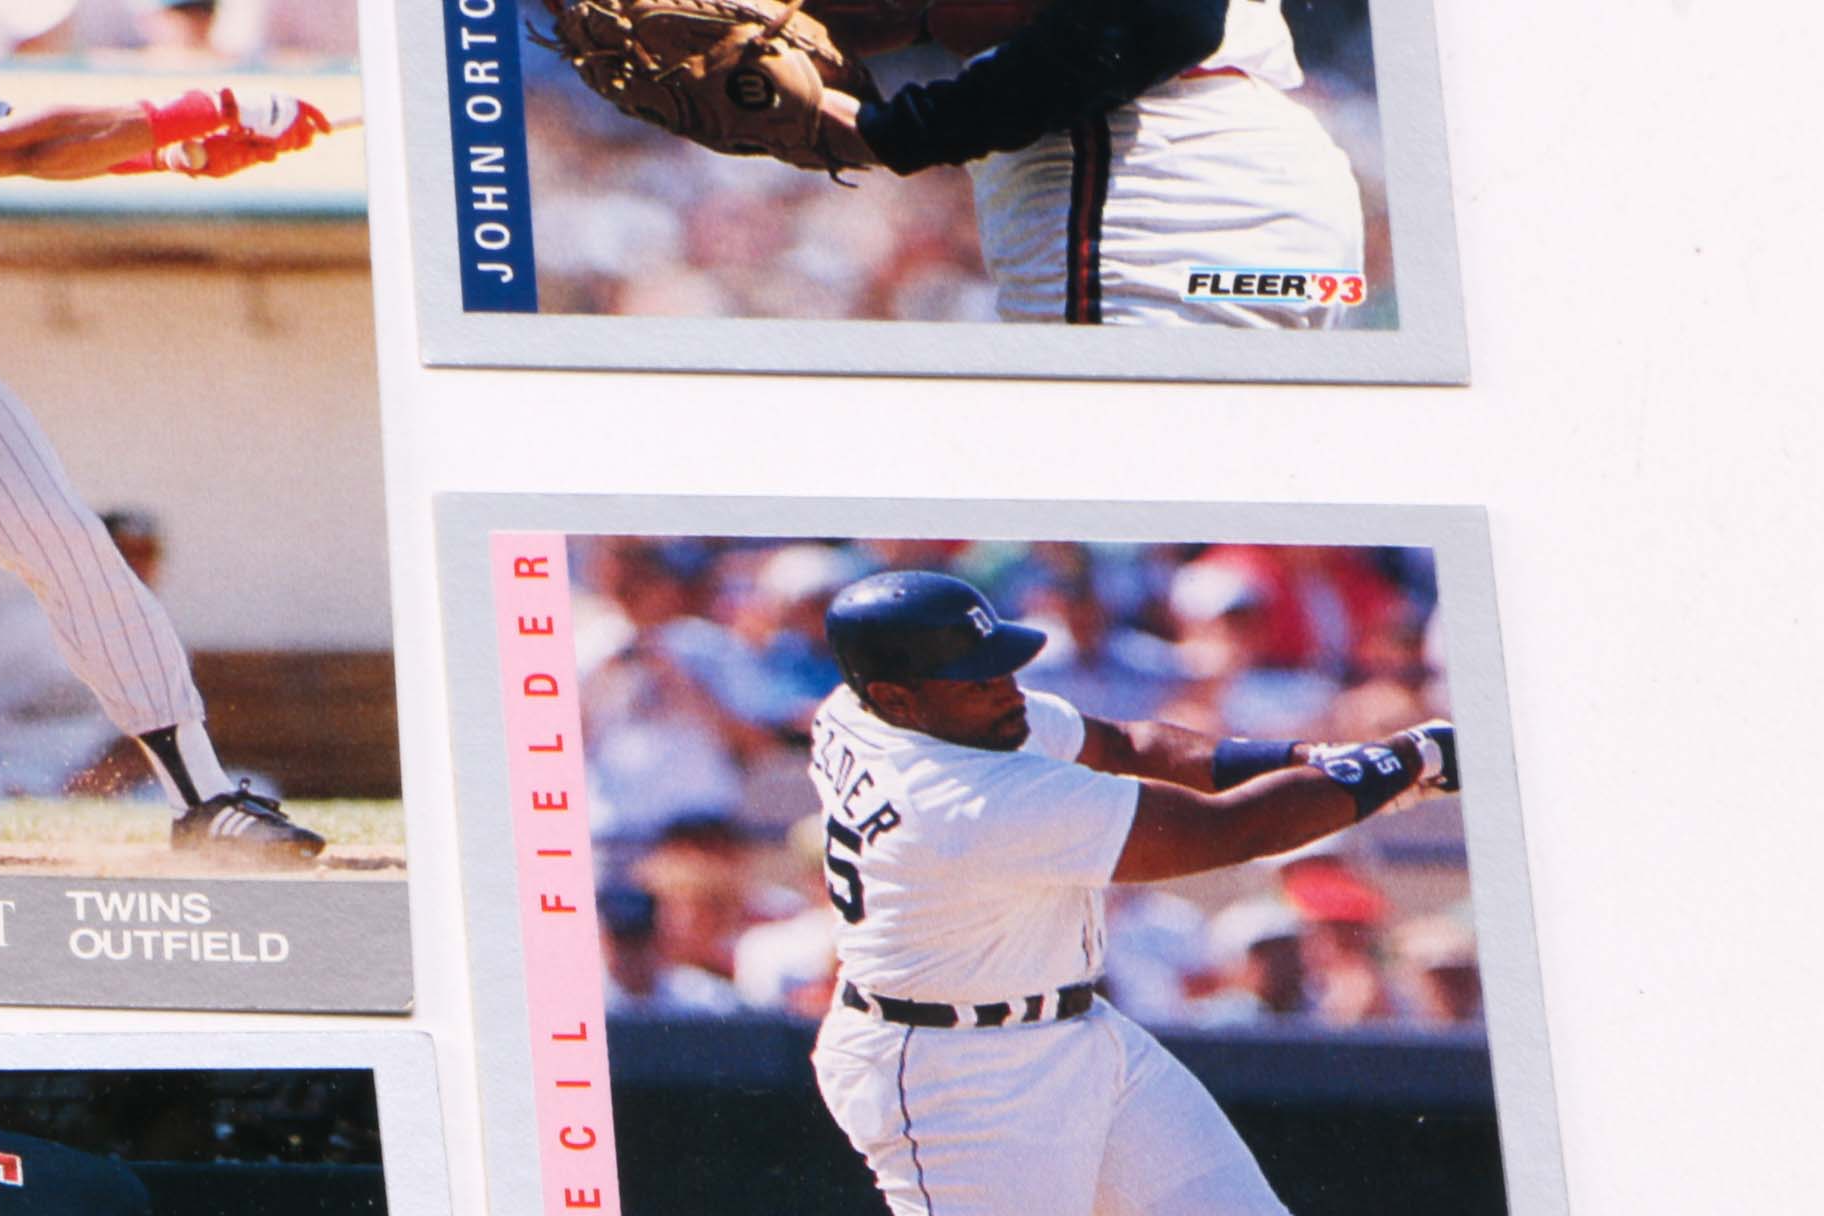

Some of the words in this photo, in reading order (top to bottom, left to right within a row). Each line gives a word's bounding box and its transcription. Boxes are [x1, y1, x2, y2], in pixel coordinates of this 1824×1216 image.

[469, 146, 514, 283] JOHN
[1188, 272, 1307, 297] FLEER
[513, 556, 577, 913] FIELDER
[65, 890, 212, 925] TWINS
[68, 927, 290, 963] OUTFIELD
